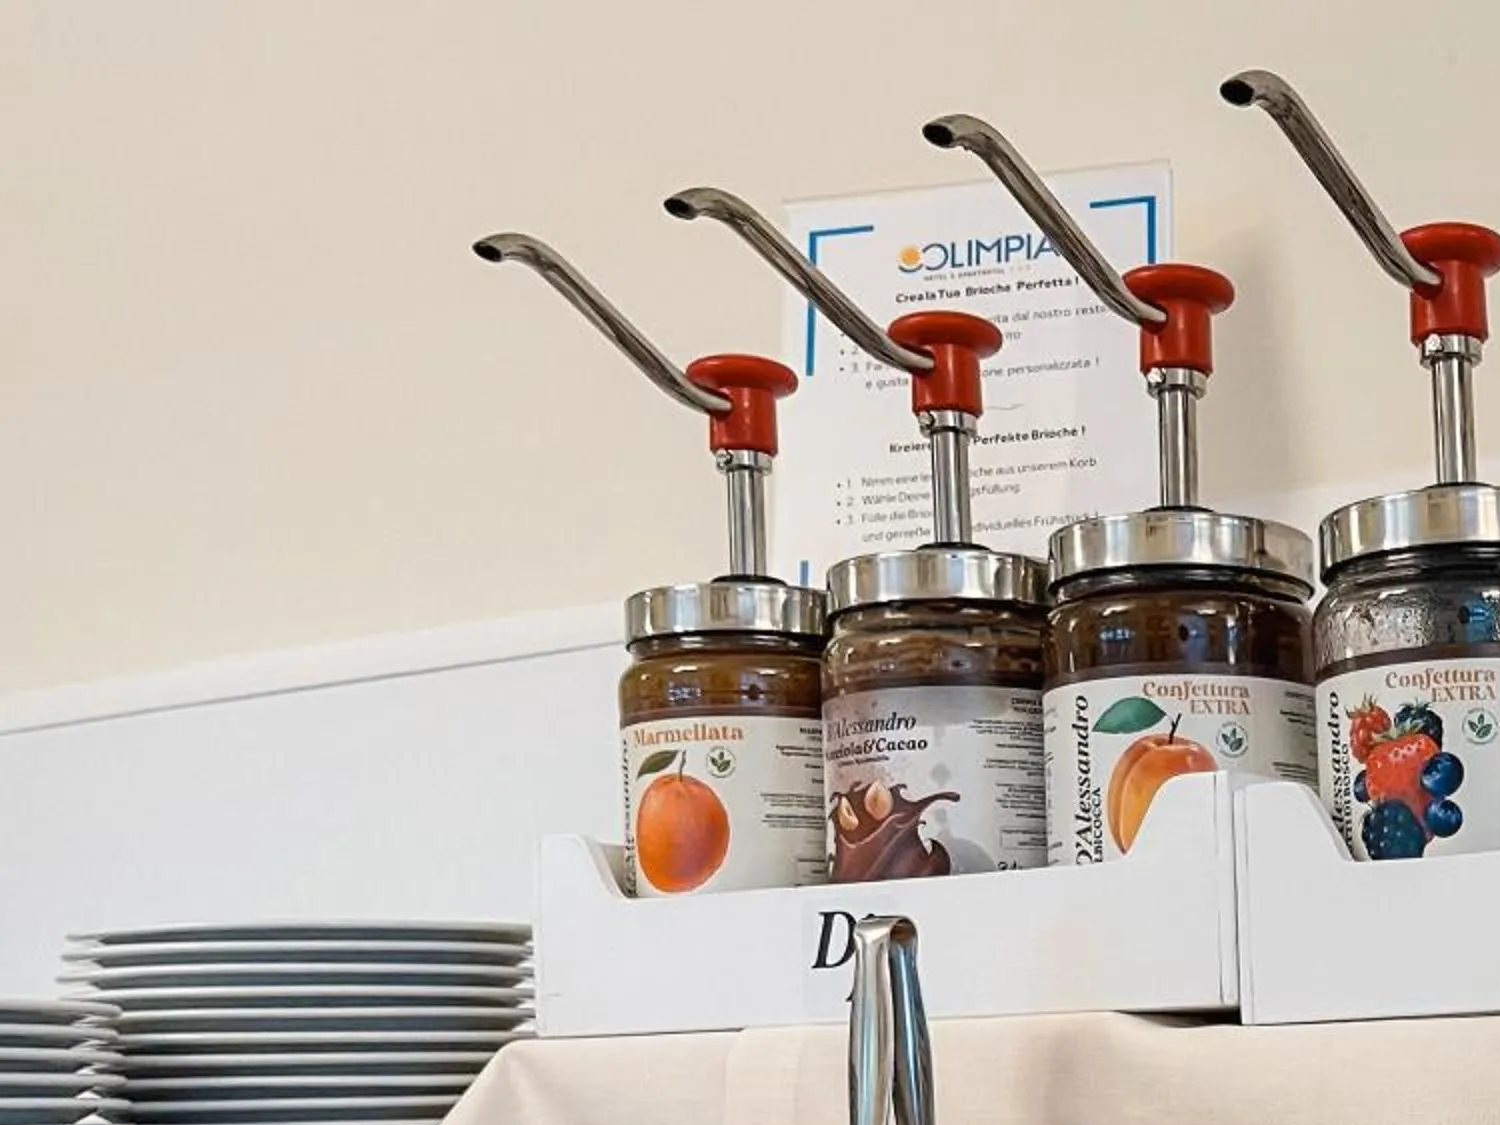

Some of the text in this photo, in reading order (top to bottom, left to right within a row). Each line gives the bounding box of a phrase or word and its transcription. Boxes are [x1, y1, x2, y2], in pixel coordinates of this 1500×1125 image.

[921, 233, 1060, 271] OLIMPIA
[937, 286, 961, 299] Tua
[966, 283, 1011, 297] Brioche
[1017, 278, 1072, 292] Perfetta
[974, 431, 1029, 446] Perfekte
[1031, 427, 1079, 440] Brioche
[1385, 667, 1497, 691] Confettura
[1142, 680, 1251, 702] Confettura
[1430, 685, 1498, 703] EXTRA
[1190, 698, 1252, 716] EXTRA
[633, 723, 745, 746] Marmellata
[1091, 786, 1104, 863] LBICOCCA
